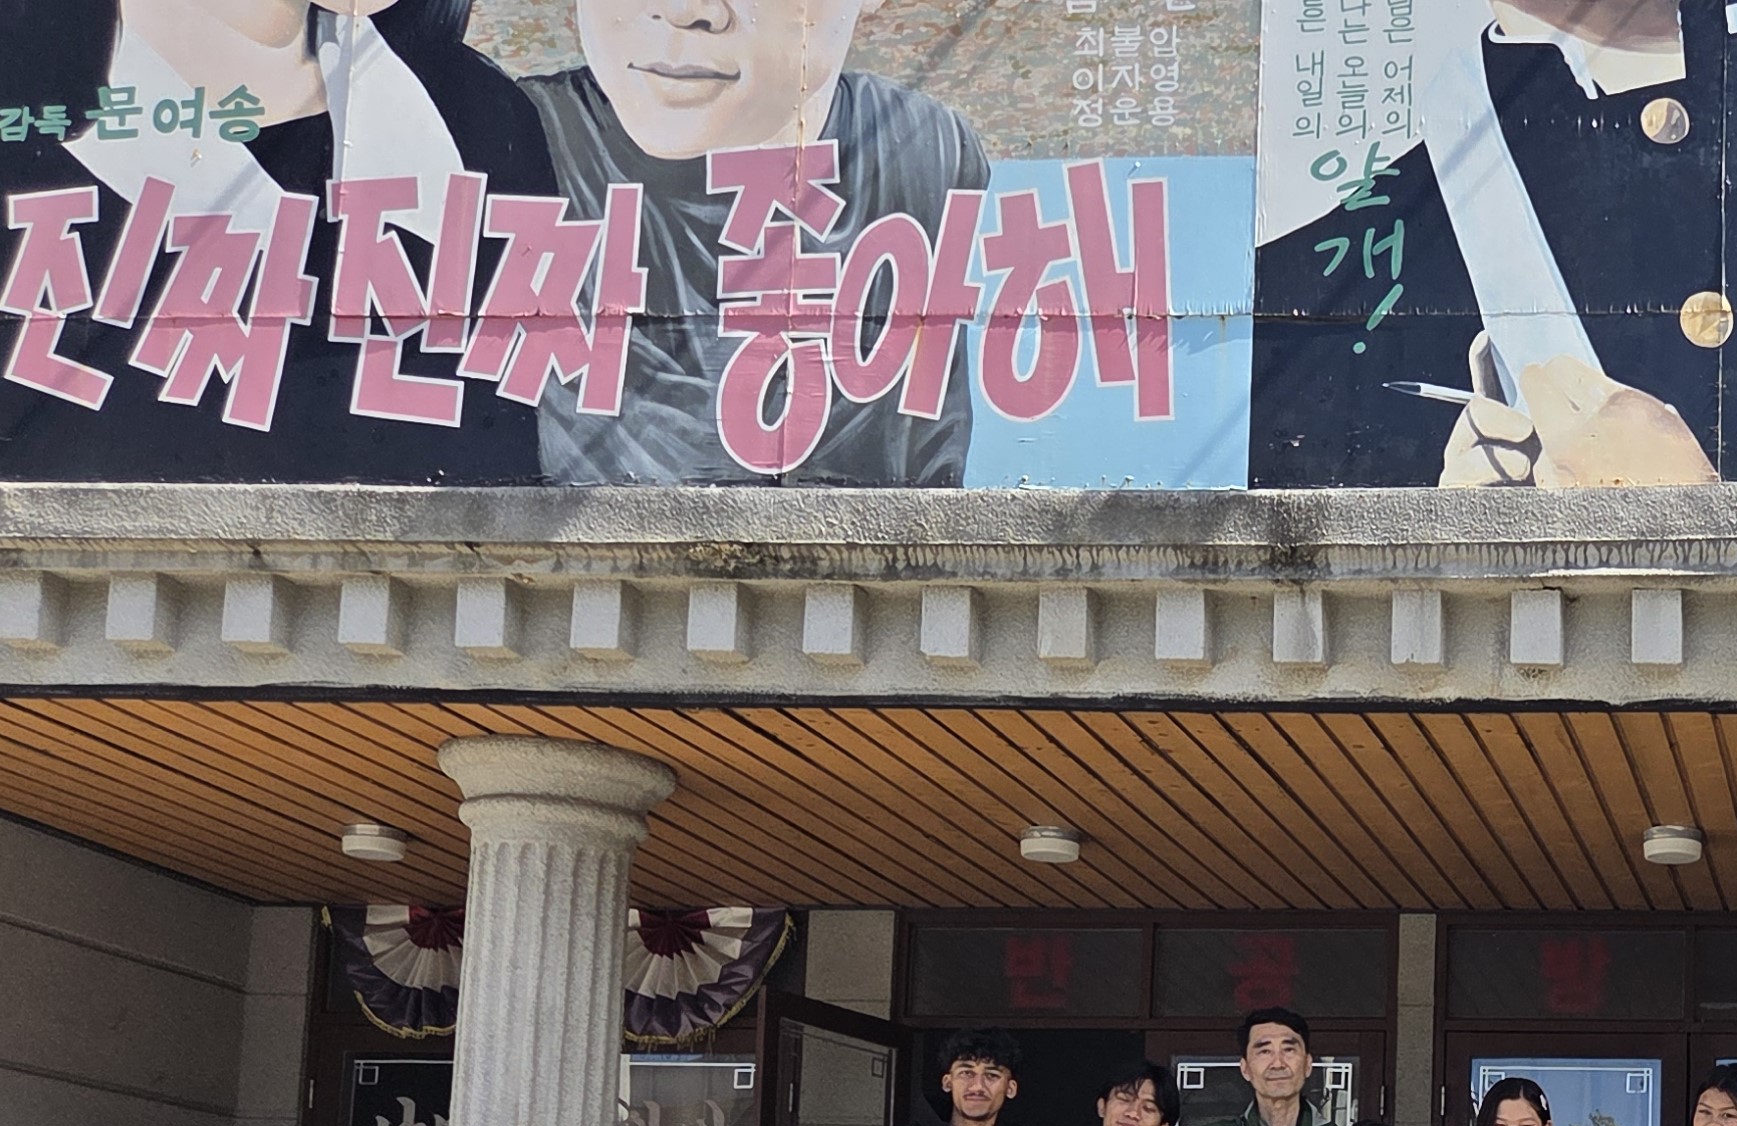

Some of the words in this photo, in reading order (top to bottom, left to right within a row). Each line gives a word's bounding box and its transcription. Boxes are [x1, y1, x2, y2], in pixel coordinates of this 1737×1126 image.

[1072, 60, 1180, 92] 이자영
[1073, 24, 1181, 57] 최불암
[0, 106, 73, 142] 감독
[86, 84, 266, 143] 문여송
[1073, 96, 1180, 127] 정운용
[1292, 50, 1325, 139] 내일의
[1335, 56, 1369, 139] 오늘의
[1381, 55, 1413, 139] 어제의
[1309, 141, 1404, 355] 얄개!
[705, 138, 1176, 475] 좋아해
